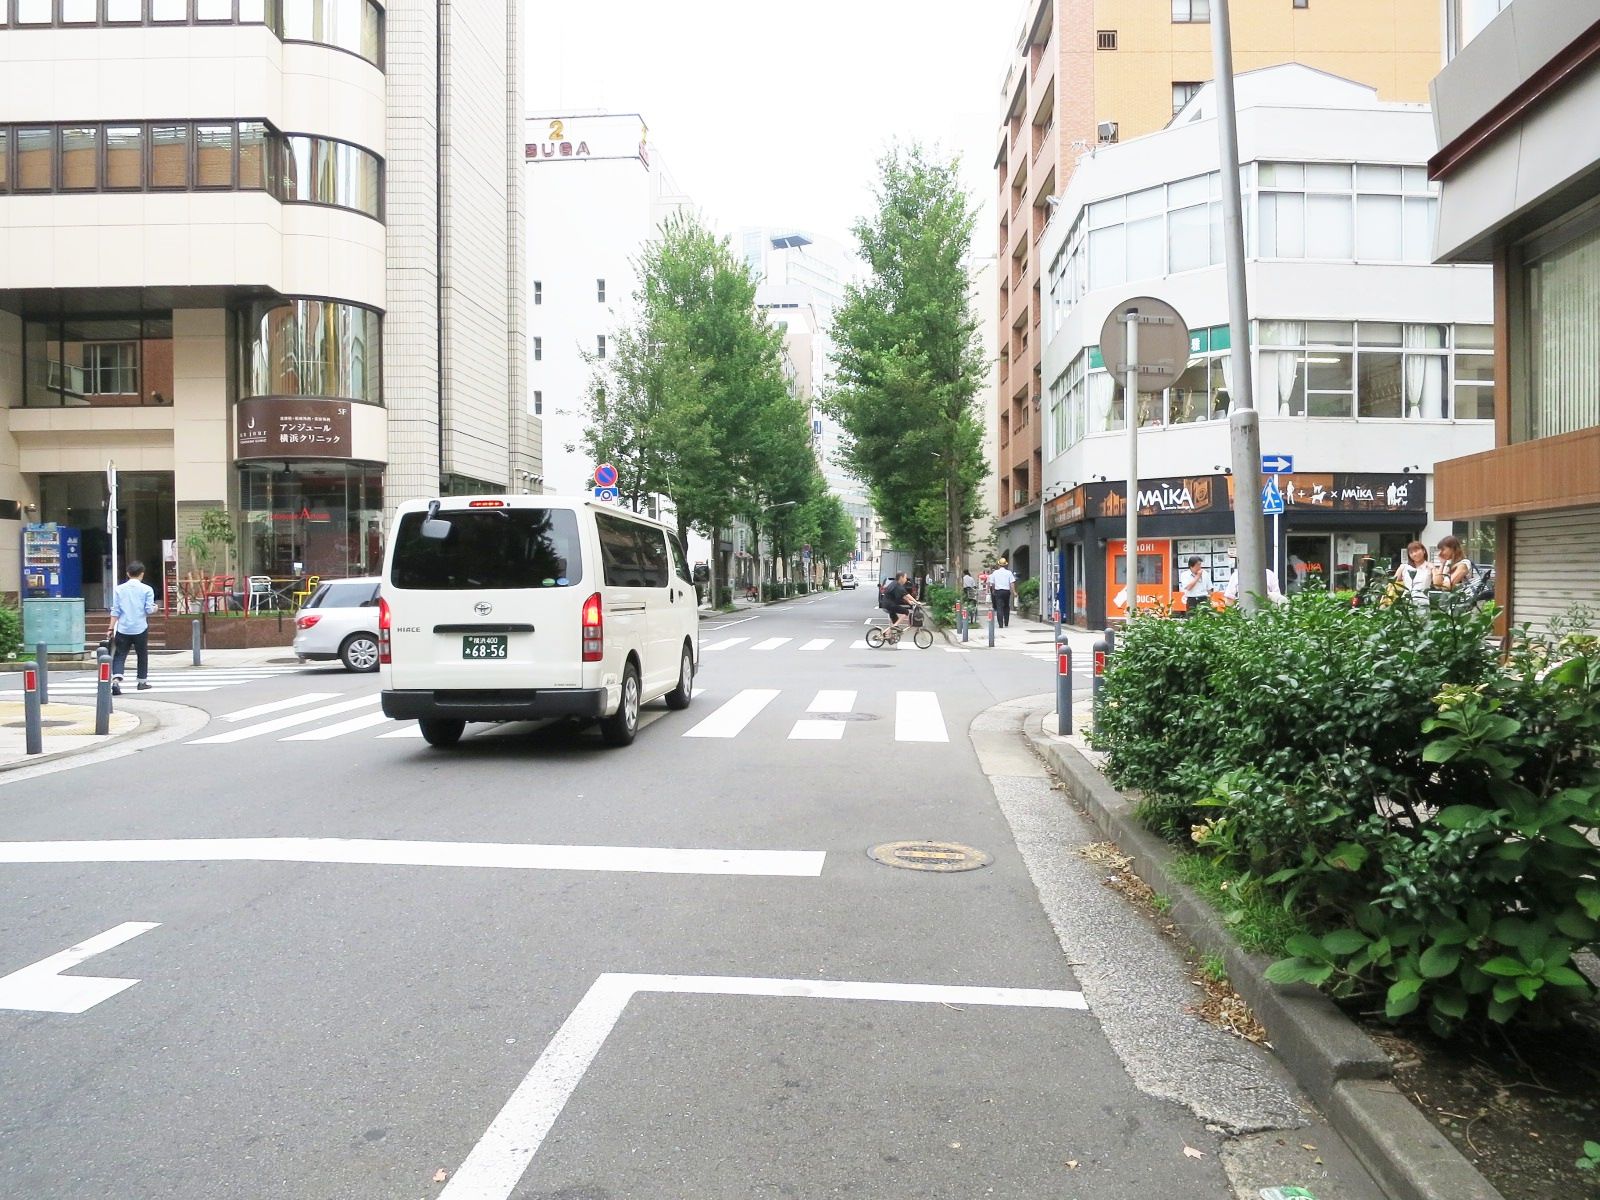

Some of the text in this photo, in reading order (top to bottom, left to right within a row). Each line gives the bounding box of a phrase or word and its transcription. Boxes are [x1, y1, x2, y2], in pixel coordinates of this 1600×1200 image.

[549, 120, 564, 140] 2
[279, 423, 332, 432] アンジュール
[279, 433, 341, 444] 横浜クリニック
[1341, 486, 1374, 501] MAIKA
[472, 644, 505, 657] 68-56
